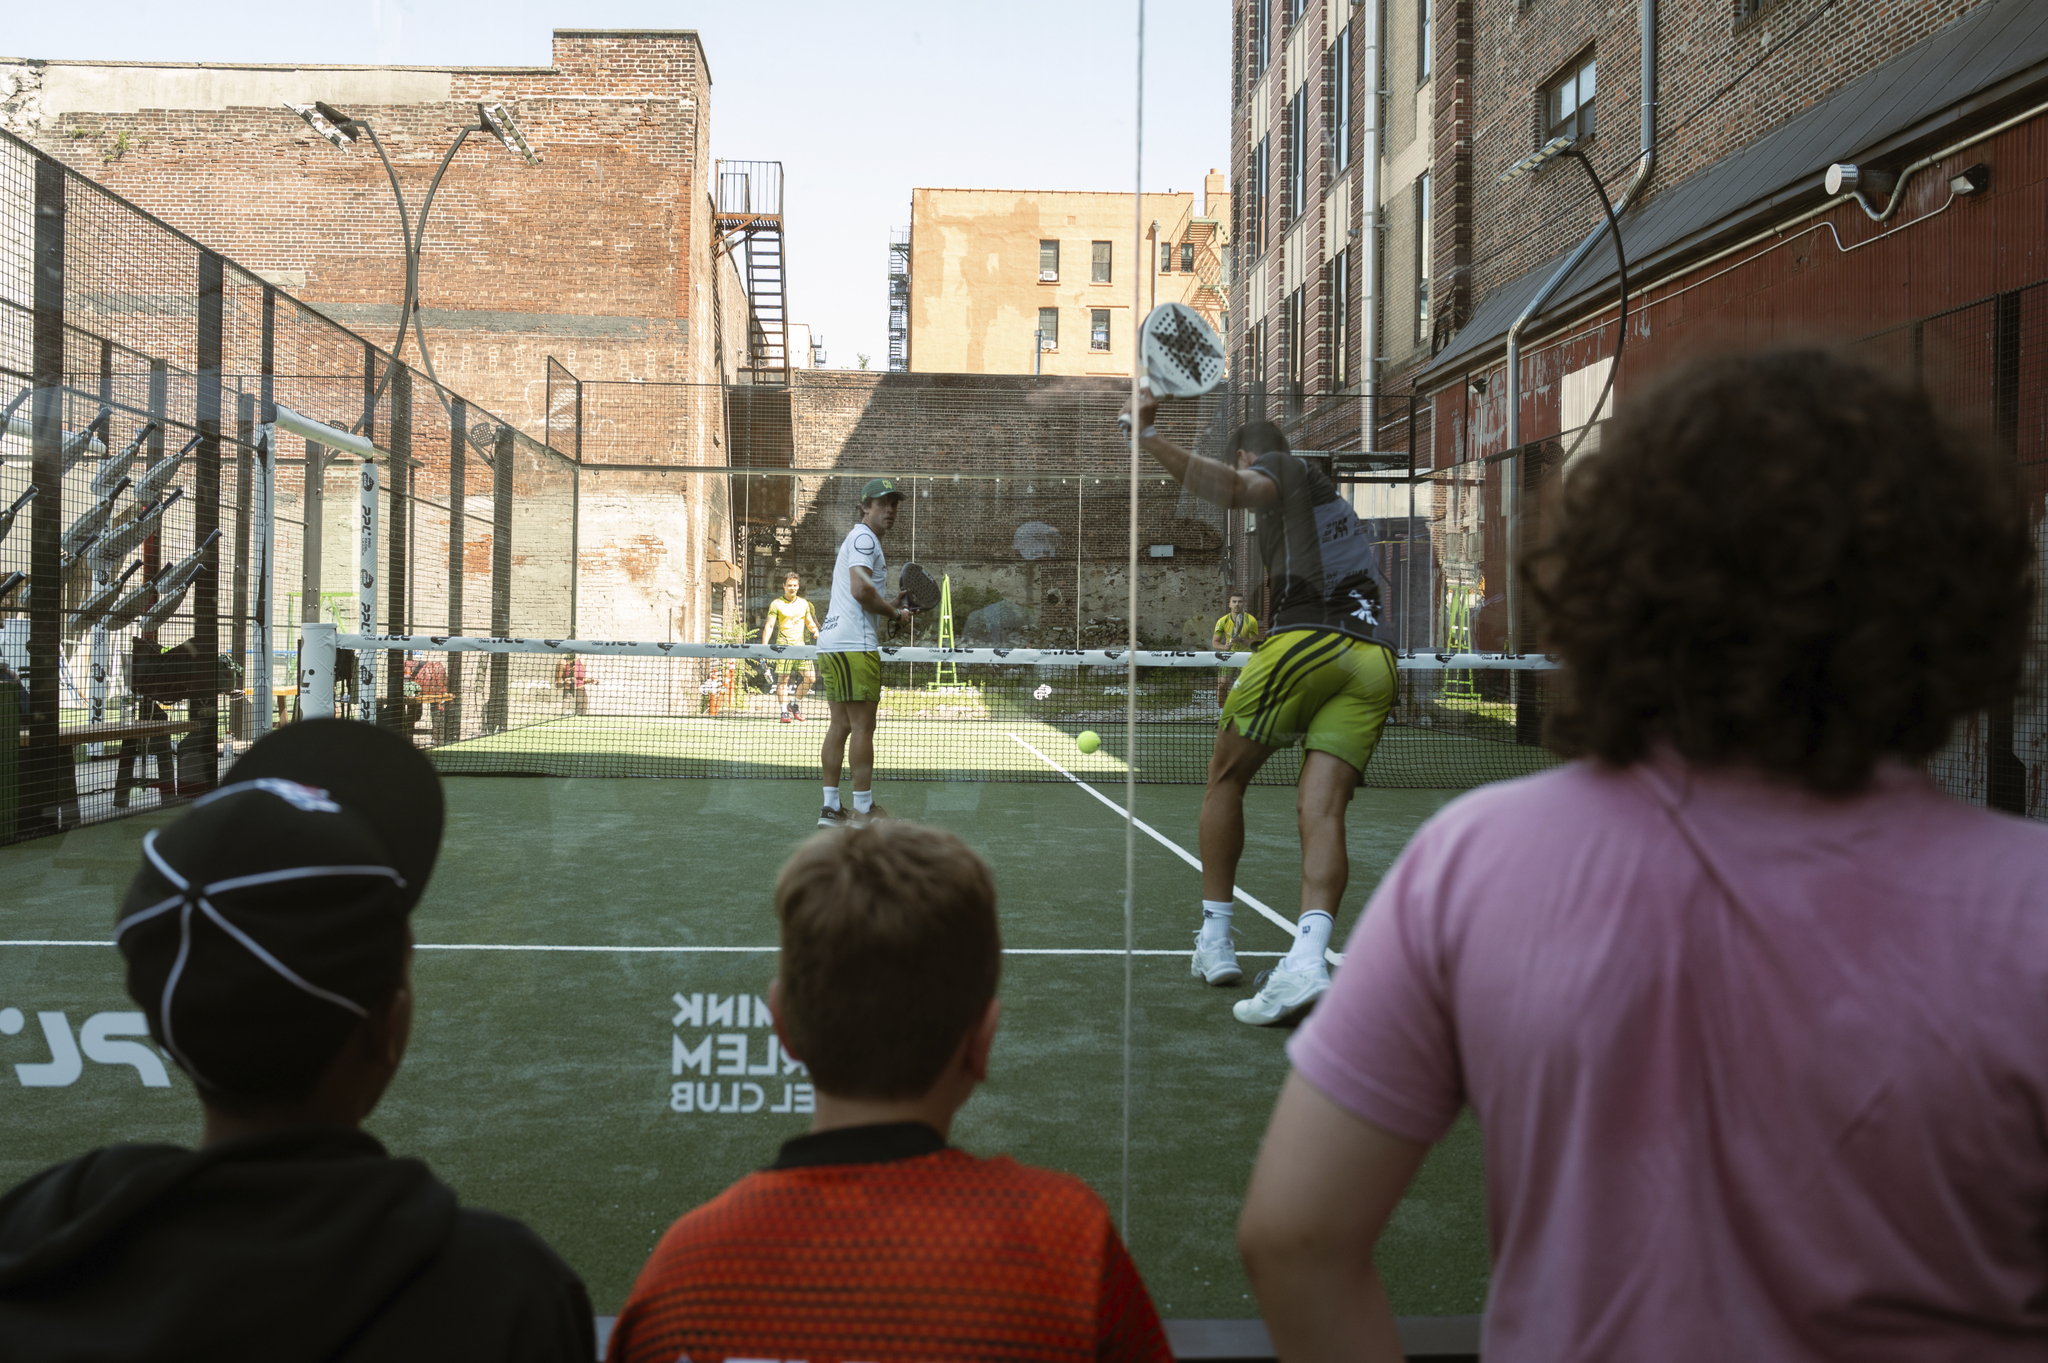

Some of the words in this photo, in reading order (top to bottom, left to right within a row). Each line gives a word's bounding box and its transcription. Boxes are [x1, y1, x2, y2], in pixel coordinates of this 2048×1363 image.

[362, 505, 371, 533] PPL
[361, 602, 370, 631] PPL
[361, 699, 370, 721] PP
